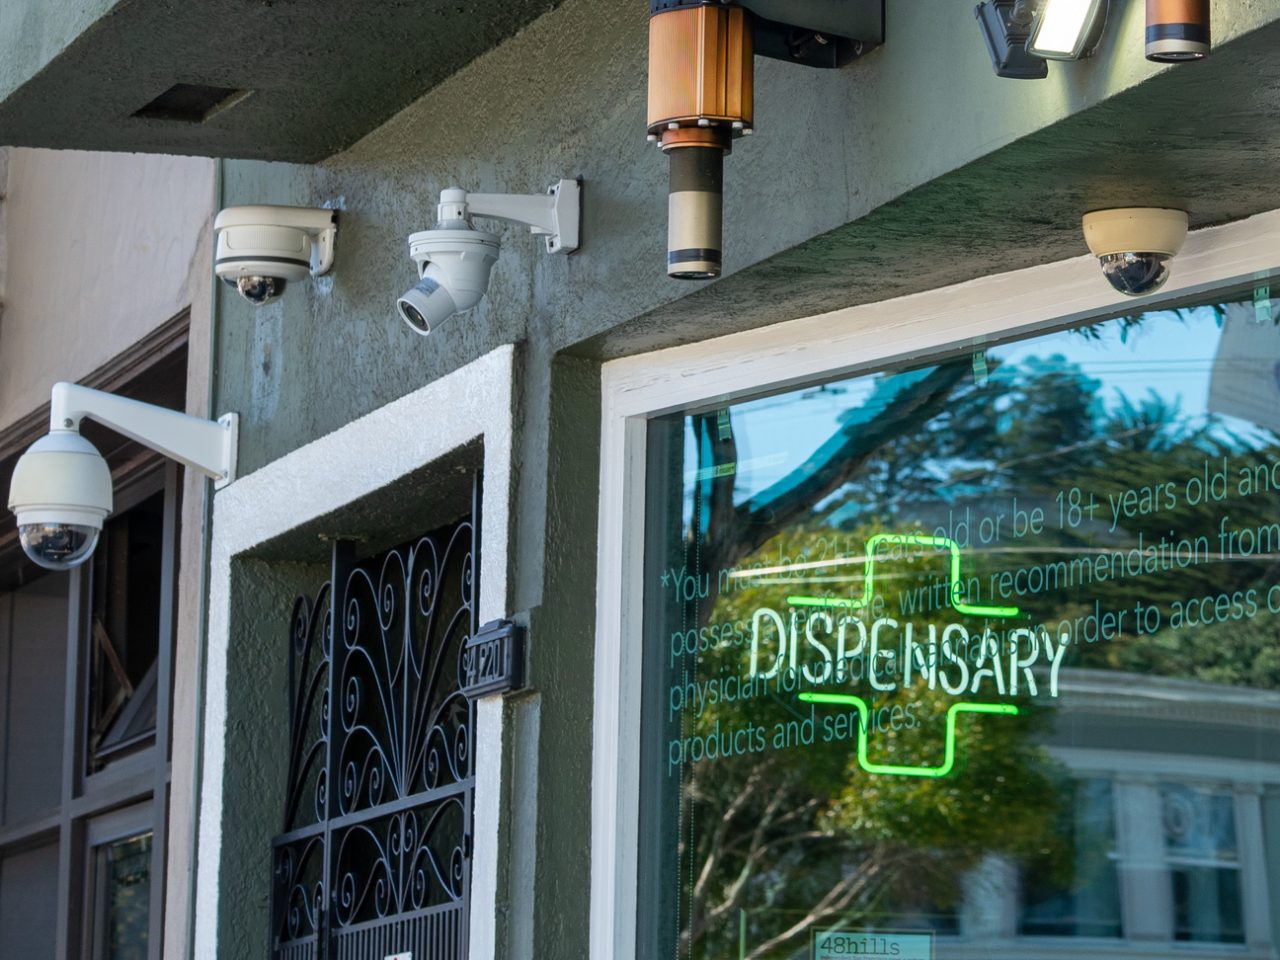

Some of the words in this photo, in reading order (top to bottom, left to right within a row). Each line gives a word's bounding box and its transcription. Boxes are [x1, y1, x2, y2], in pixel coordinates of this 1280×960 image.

[718, 557, 772, 594] must
[779, 542, 807, 580] be
[815, 536, 856, 576] 21+
[864, 529, 924, 577] years
[932, 506, 970, 553] old
[979, 511, 1006, 544] or
[1013, 496, 1044, 538] be
[1055, 487, 1100, 529] 18+
[1108, 481, 1177, 533] years
[1186, 456, 1228, 506] old
[669, 665, 767, 722] physician
[776, 653, 804, 693] for
[814, 633, 903, 687] medical
[912, 618, 1018, 670] cannabis
[1027, 613, 1047, 652] in
[1057, 599, 1127, 646] order
[1134, 601, 1160, 635] to
[1170, 588, 1258, 630] access
[670, 617, 756, 668] possess
[899, 575, 980, 616] written
[990, 530, 1209, 600] recommendation
[749, 606, 1069, 698] DISPENSARY
[668, 720, 765, 777] products
[773, 703, 815, 750] and
[822, 697, 921, 742] services.
[820, 936, 901, 956] 48hills
